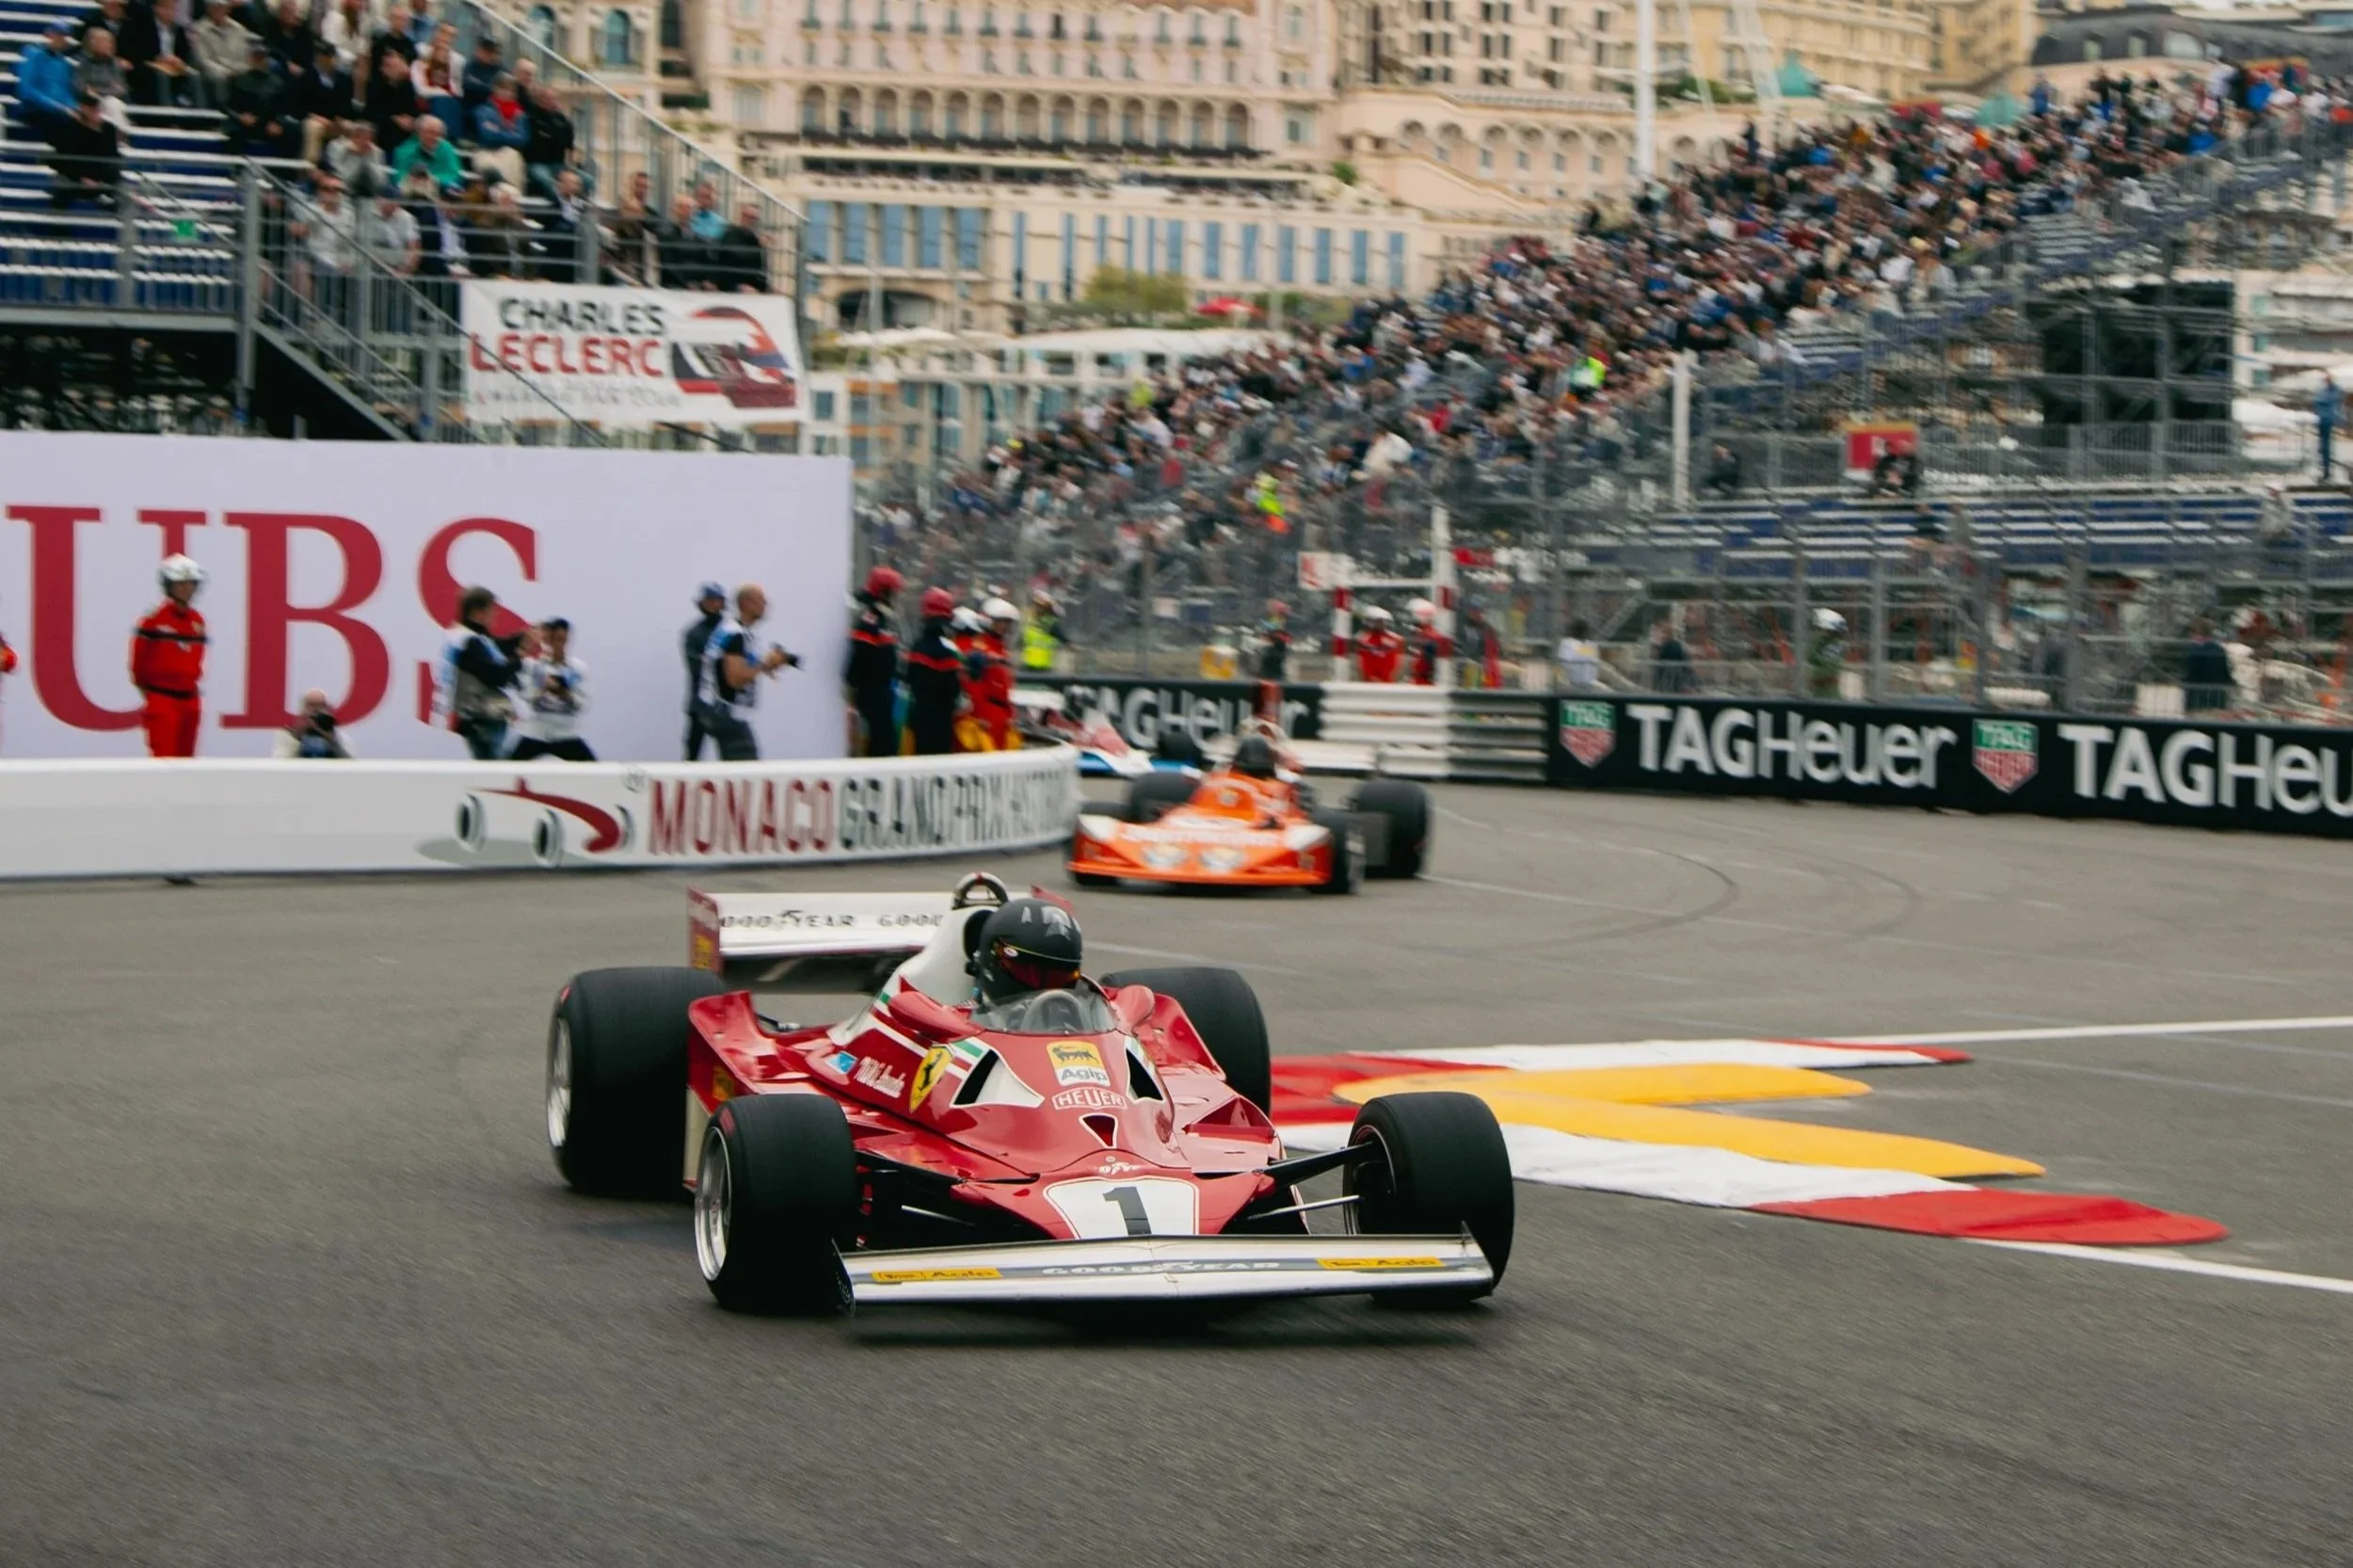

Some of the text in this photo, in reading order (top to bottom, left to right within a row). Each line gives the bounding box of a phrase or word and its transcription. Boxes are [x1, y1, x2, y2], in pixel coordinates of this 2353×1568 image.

[500, 296, 666, 336] CHARLES
[469, 331, 665, 377] LECLERC
[6, 504, 548, 733] UBS
[648, 778, 835, 856] MONACO
[1061, 1067, 1108, 1082] Agip
[1057, 1088, 1124, 1107] HEUER
[1102, 1185, 1153, 1236] 1
[1042, 1260, 1281, 1275] GOODYEAR
